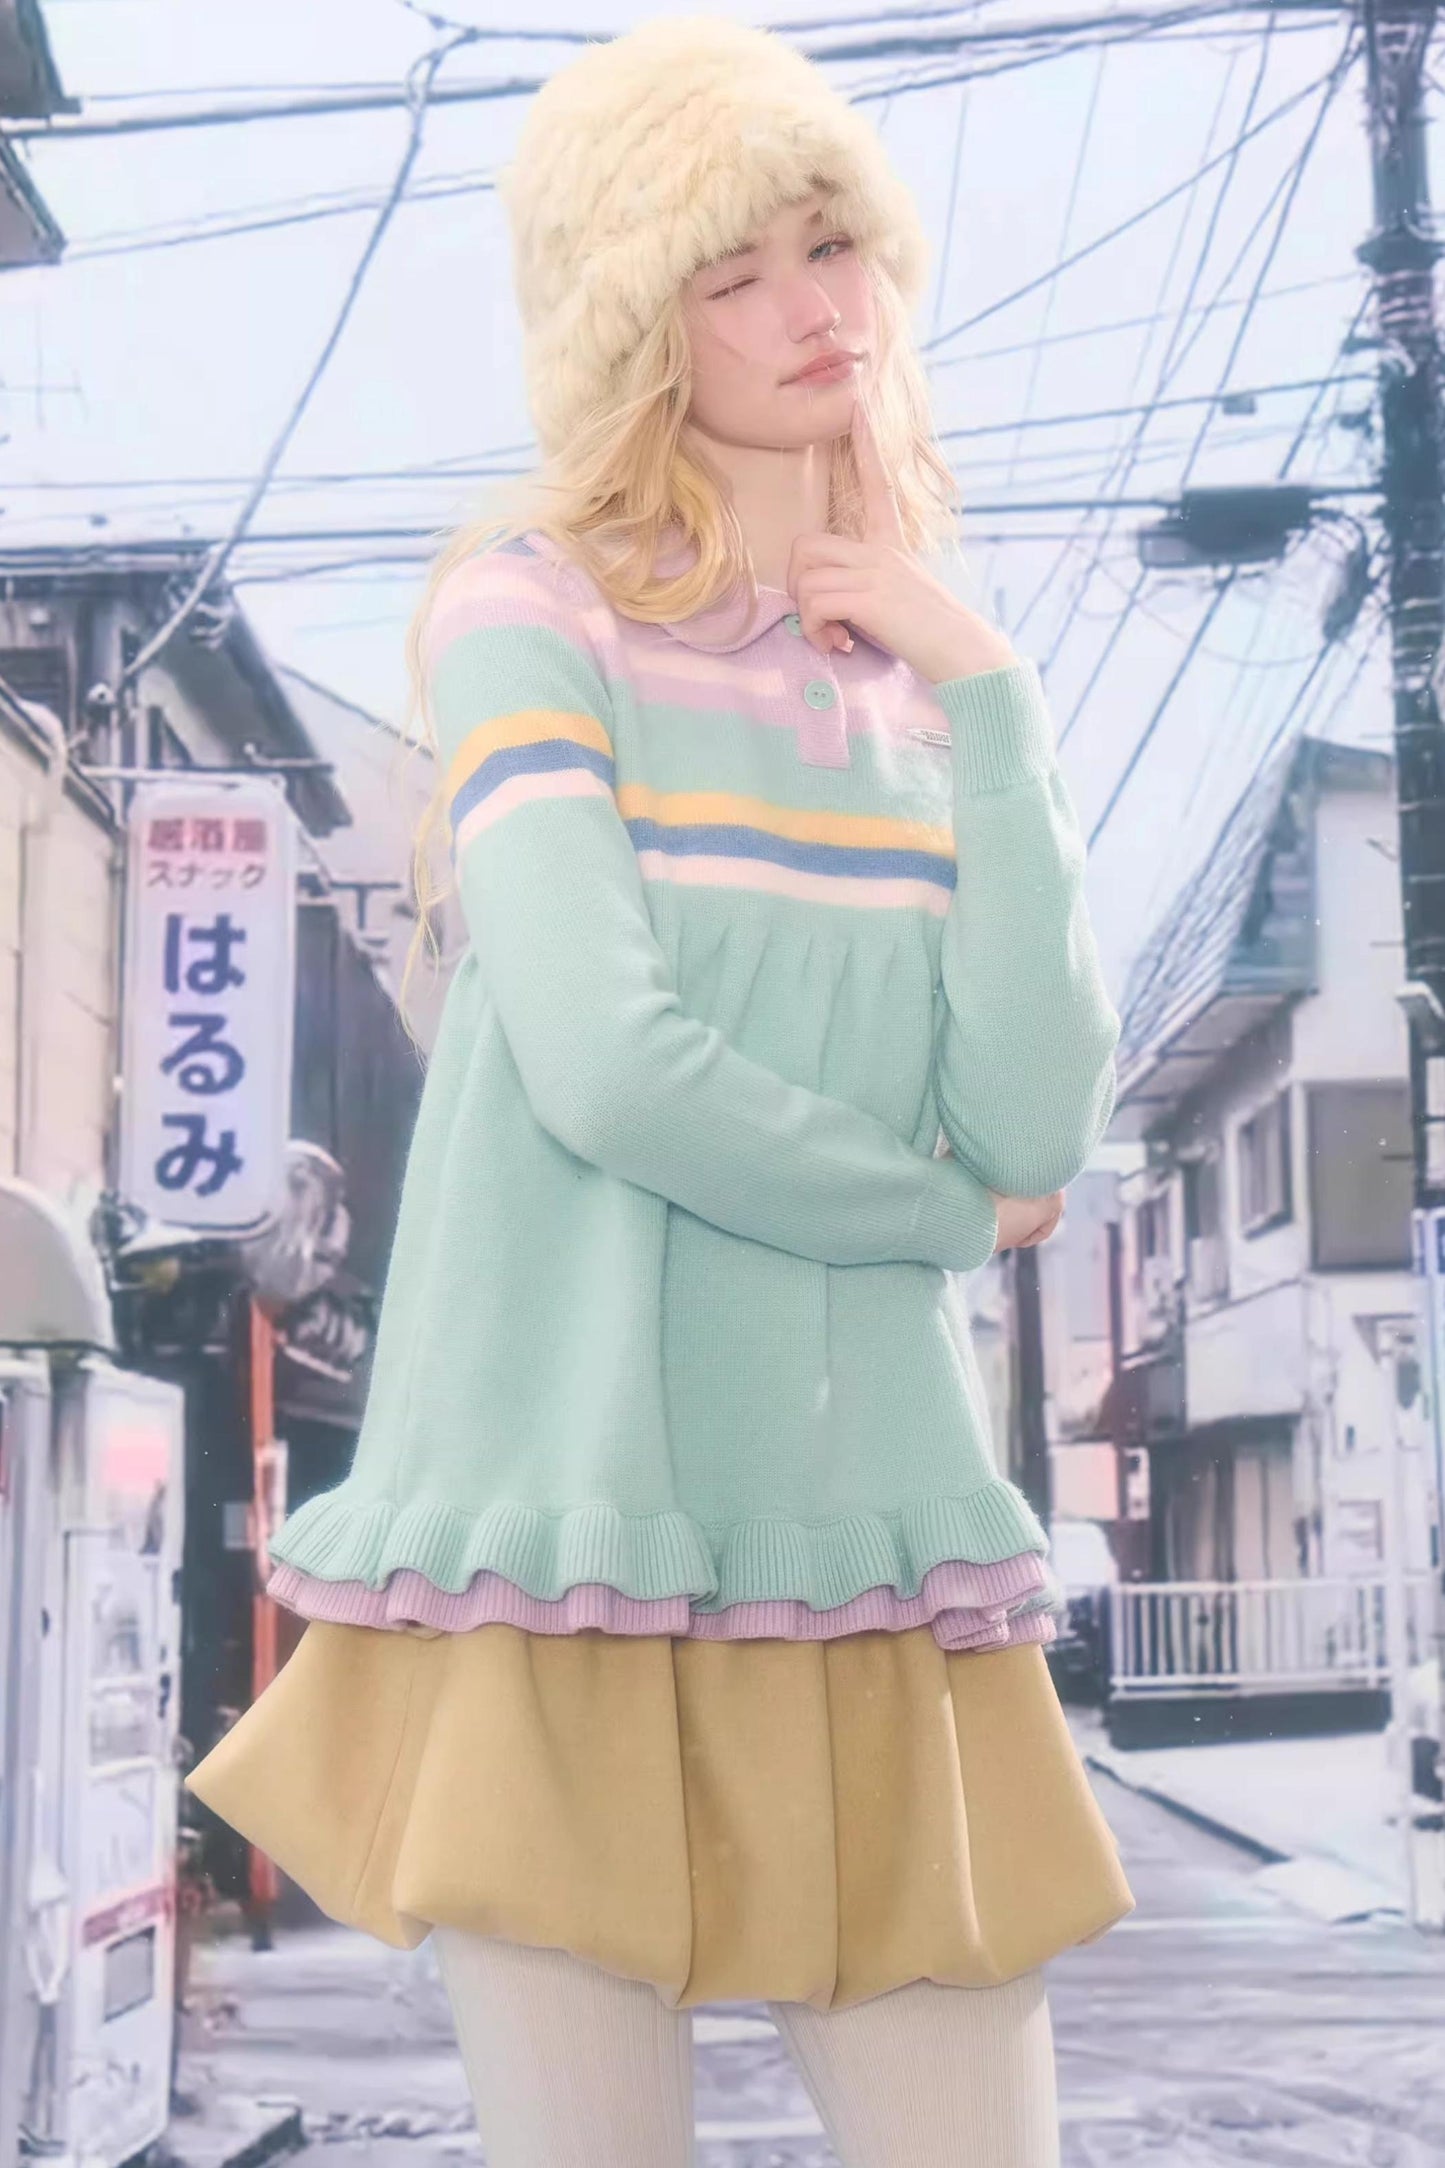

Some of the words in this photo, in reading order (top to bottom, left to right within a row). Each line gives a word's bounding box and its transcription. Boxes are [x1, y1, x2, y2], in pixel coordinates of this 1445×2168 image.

[147, 860, 267, 890] スナック
[155, 913, 246, 1198] はるみ
